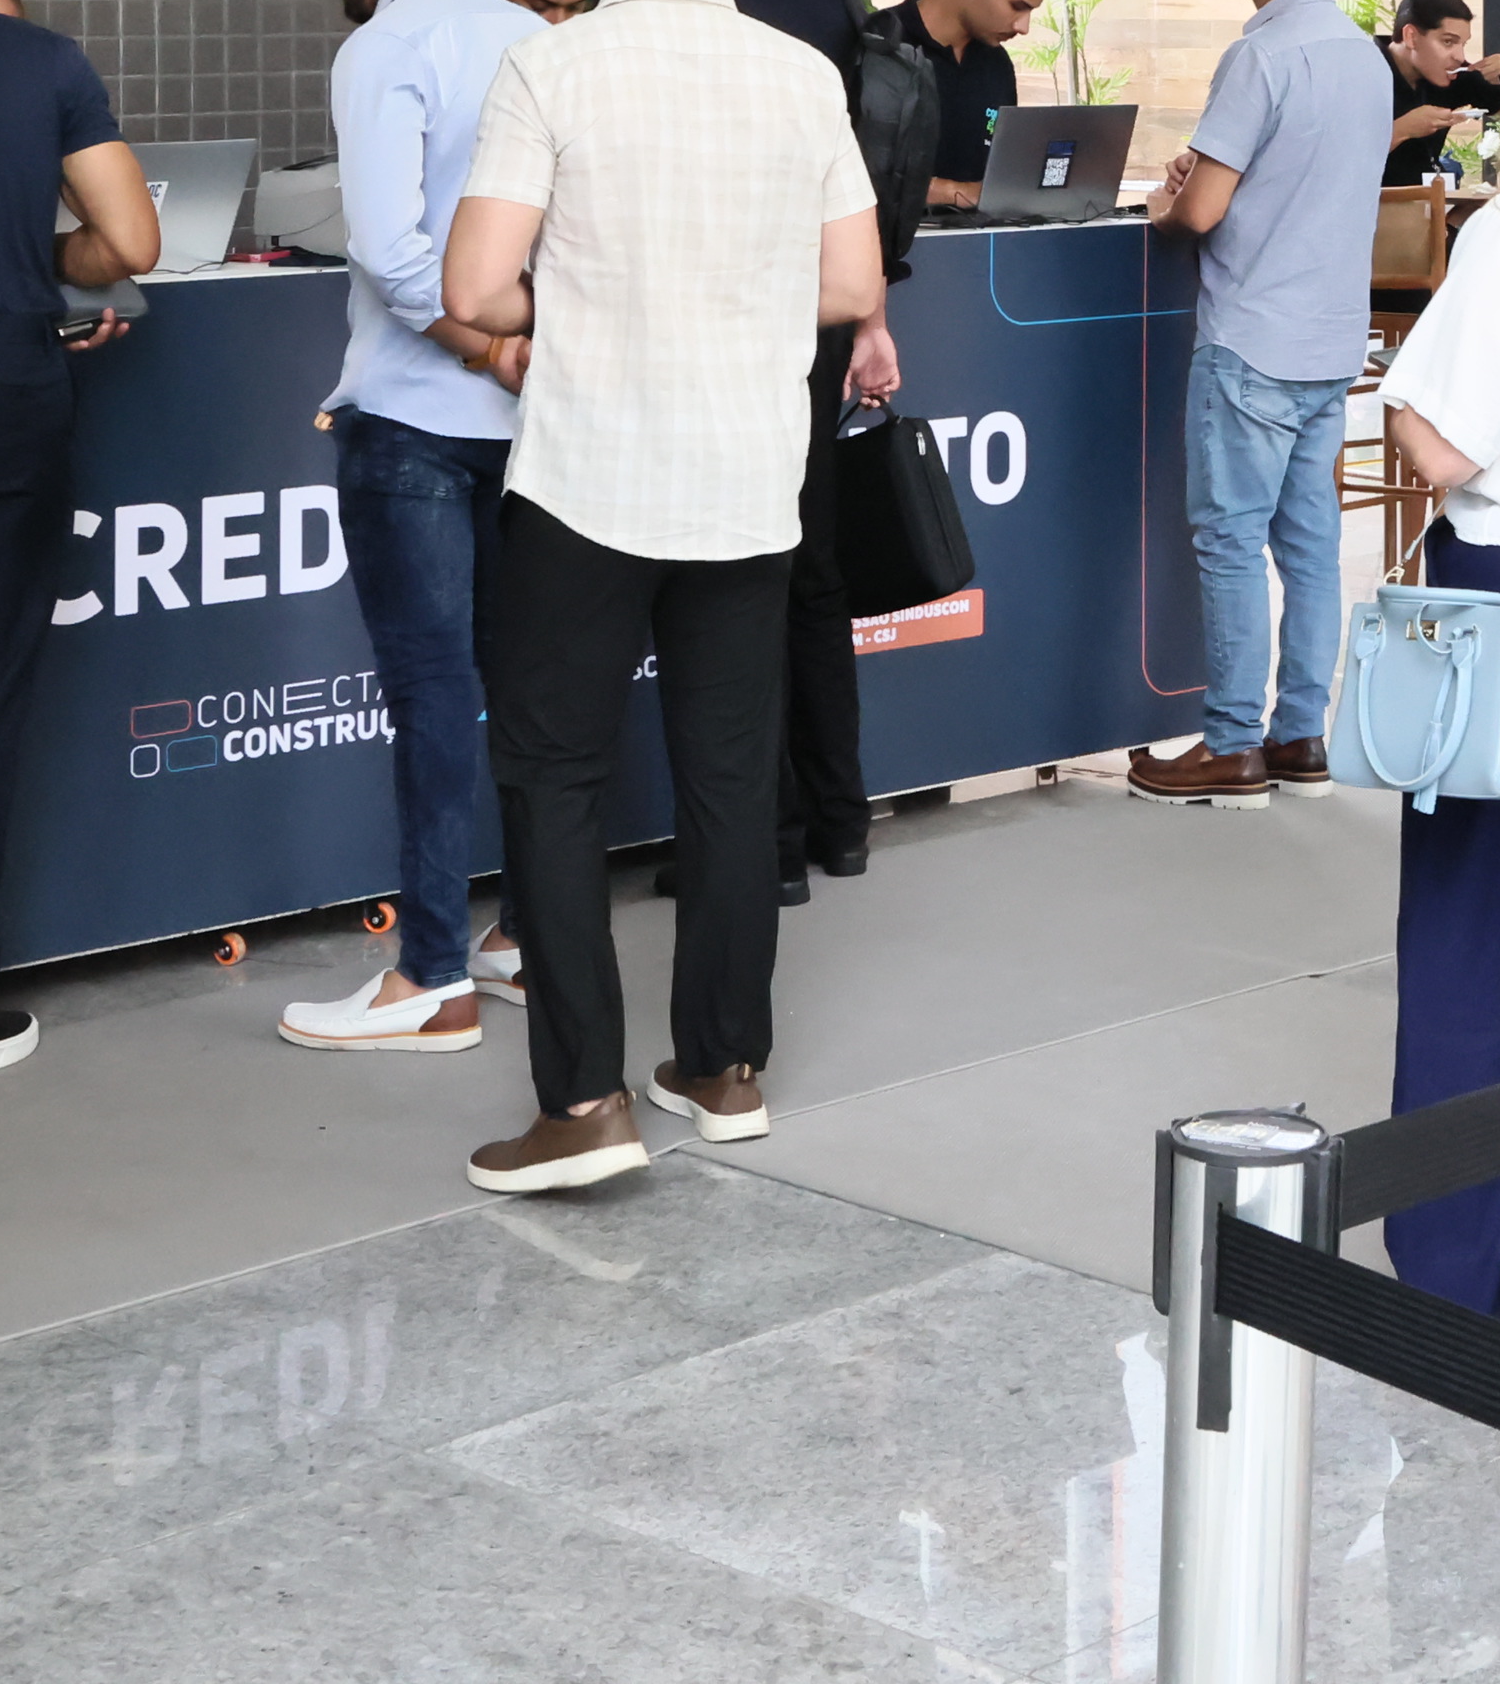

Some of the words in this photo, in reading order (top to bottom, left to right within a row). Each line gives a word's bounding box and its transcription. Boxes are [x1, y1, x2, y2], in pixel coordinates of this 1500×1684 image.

[892, 598, 970, 624] SINDUSCON
[874, 626, 897, 644] CSJ
[198, 670, 383, 728] CONECT
